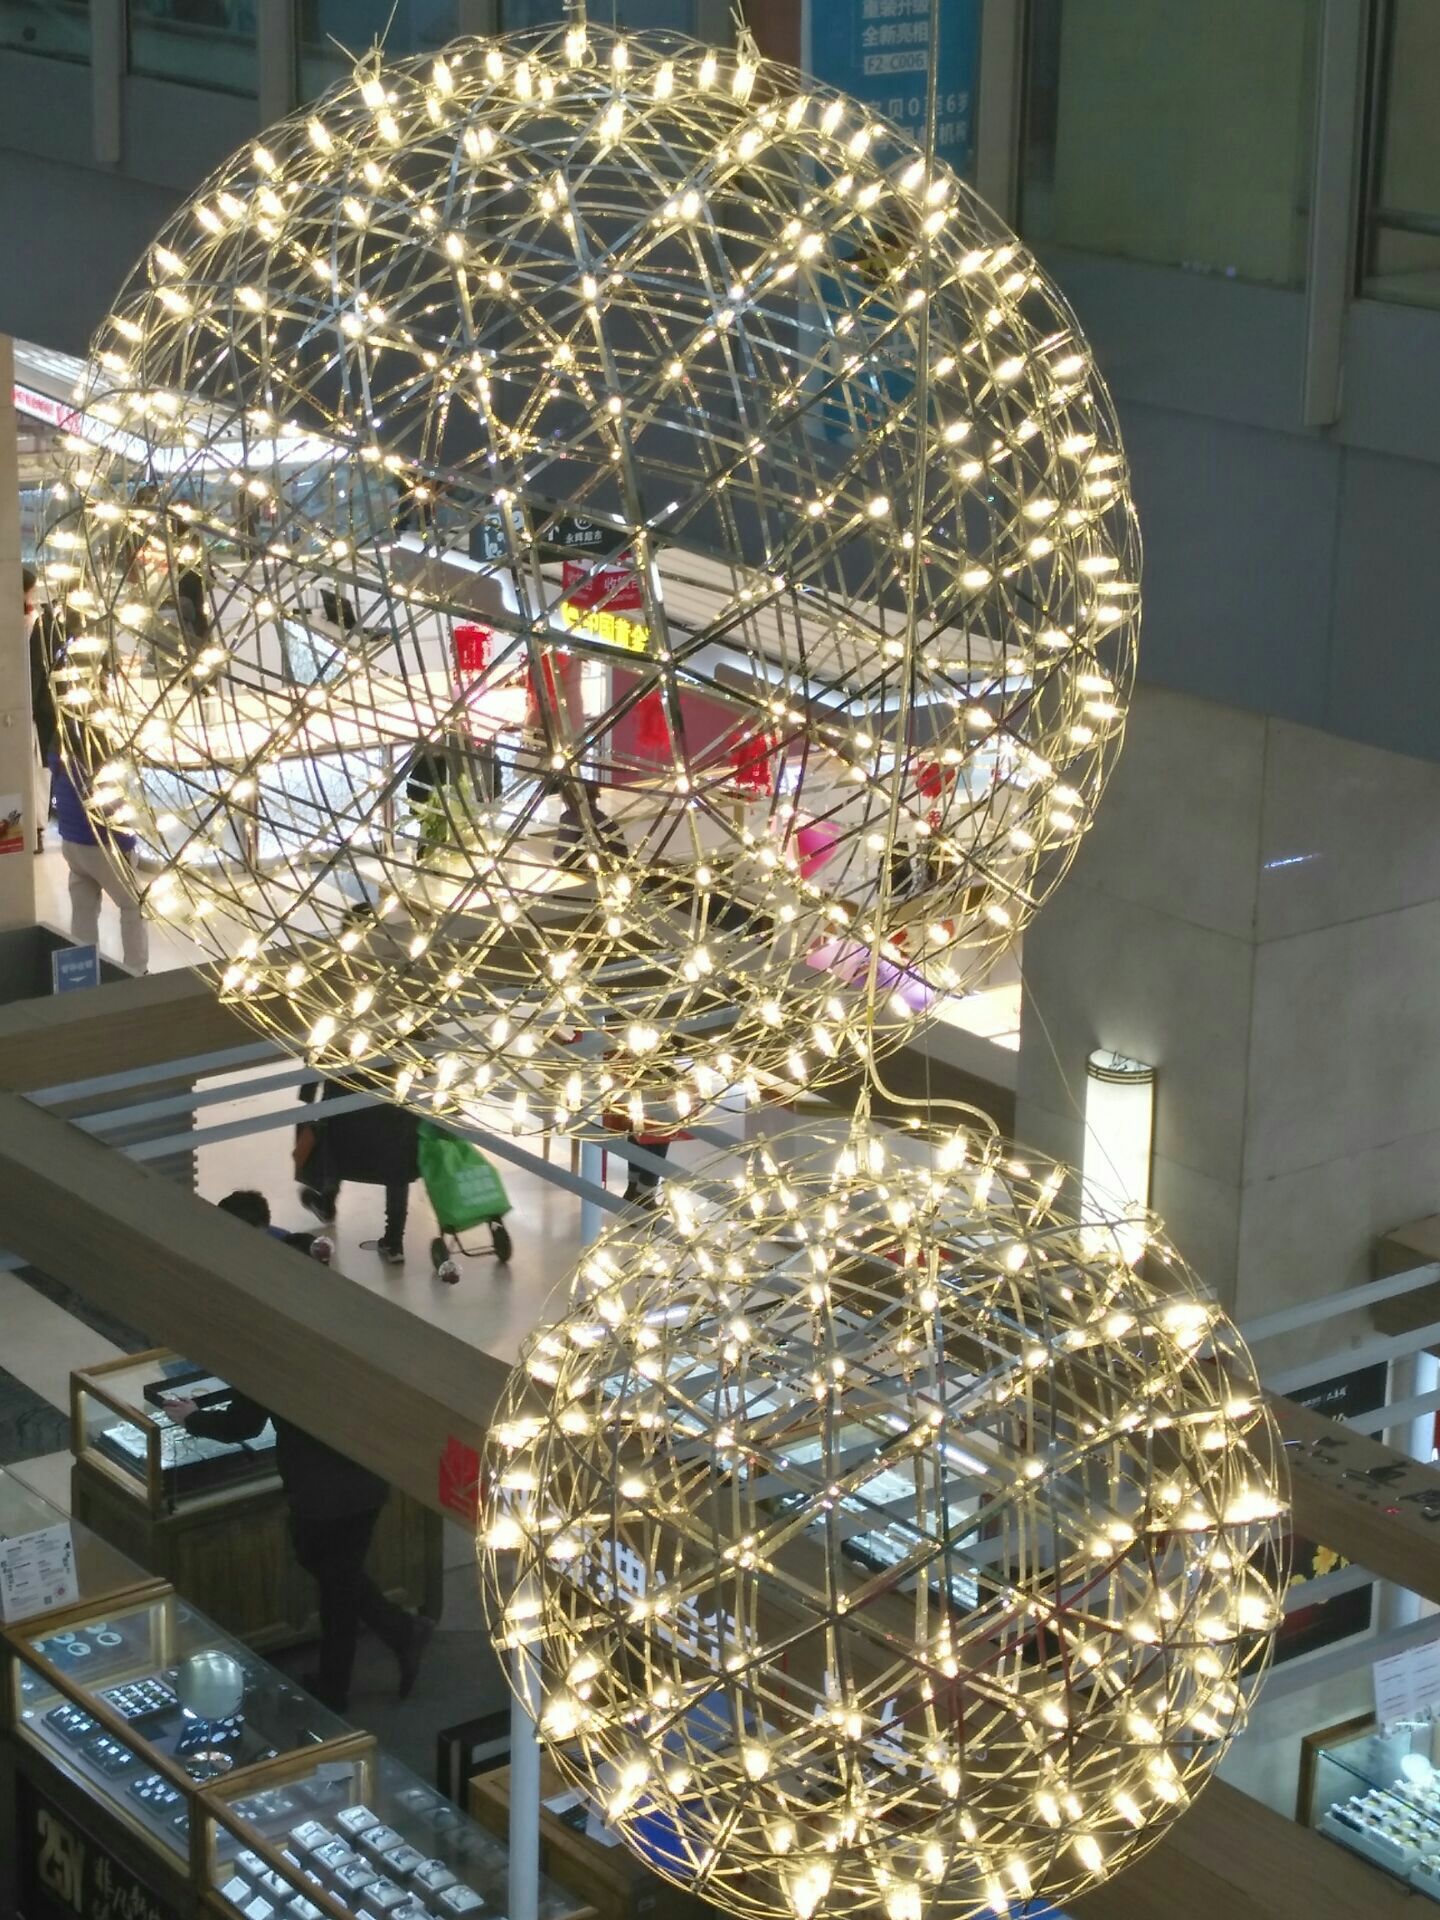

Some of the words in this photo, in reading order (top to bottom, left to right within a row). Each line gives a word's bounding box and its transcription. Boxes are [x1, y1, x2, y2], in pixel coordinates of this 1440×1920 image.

[862, 21, 929, 47] 全新亮相
[566, 530, 603, 544] 永辉超市
